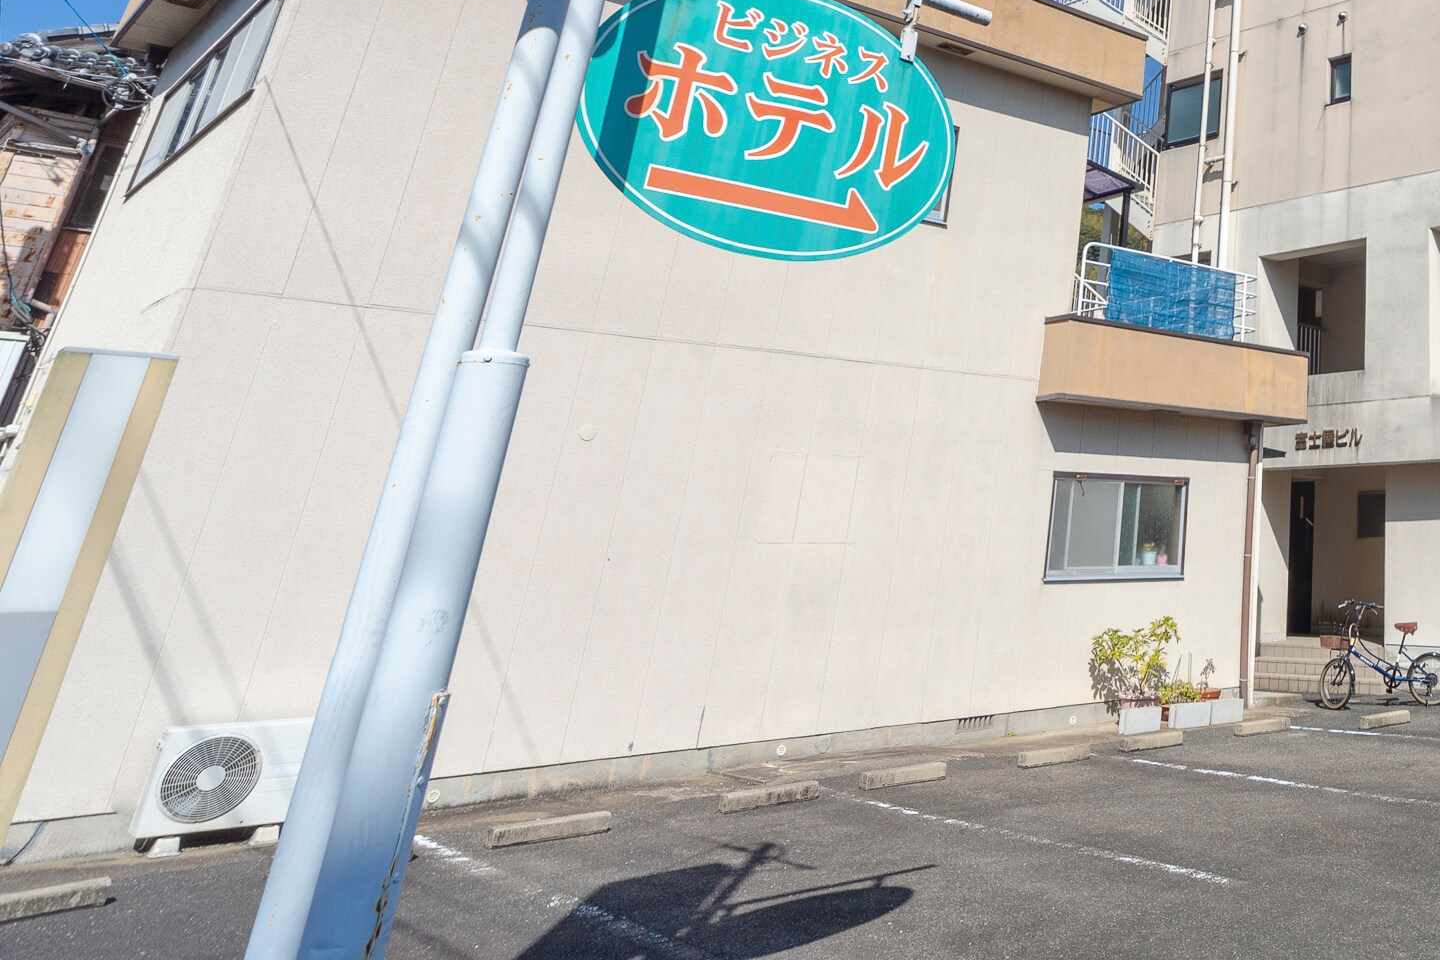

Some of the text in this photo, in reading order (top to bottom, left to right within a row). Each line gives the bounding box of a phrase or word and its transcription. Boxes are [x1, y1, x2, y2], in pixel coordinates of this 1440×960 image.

[713, 0, 890, 93] ビジネス
[624, 42, 930, 191] ホテル
